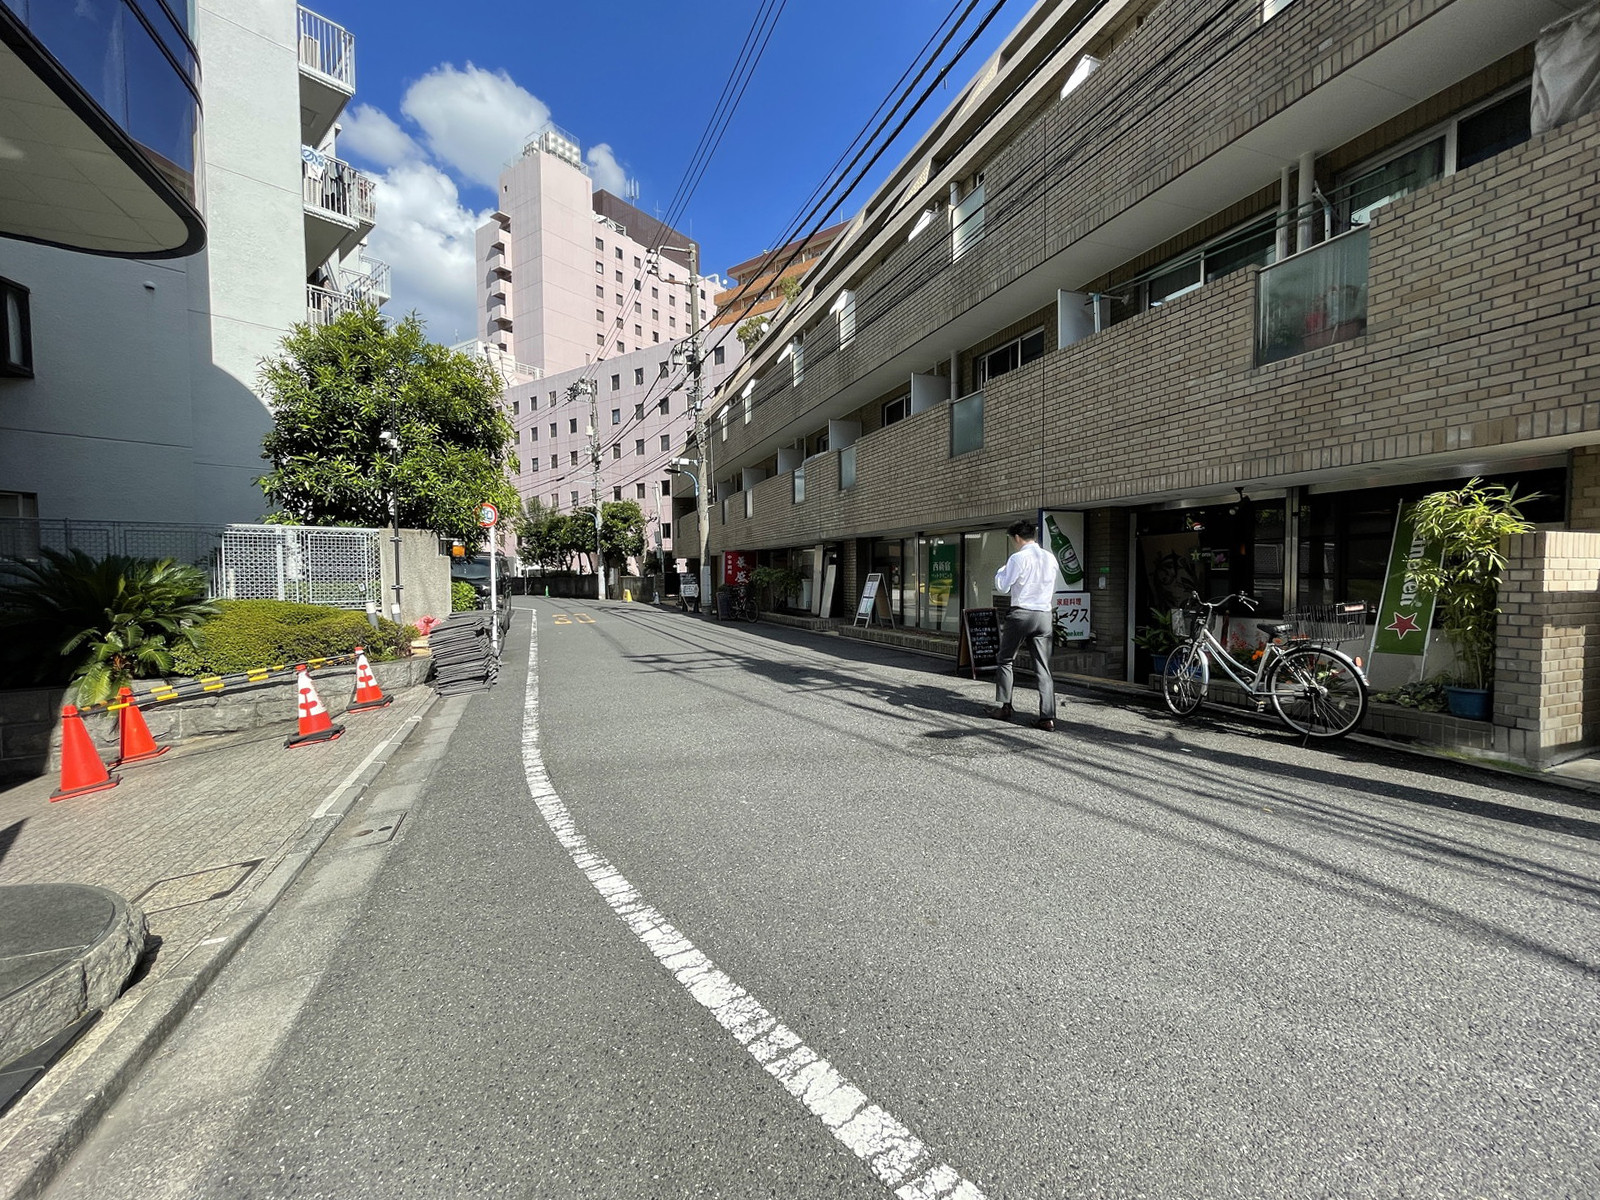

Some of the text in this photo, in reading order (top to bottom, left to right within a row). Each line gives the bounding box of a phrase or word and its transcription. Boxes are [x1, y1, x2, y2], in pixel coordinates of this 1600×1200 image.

[1400, 517, 1427, 606] ineen
[1056, 598, 1082, 606] 家庭料理
[552, 613, 596, 624] 30
